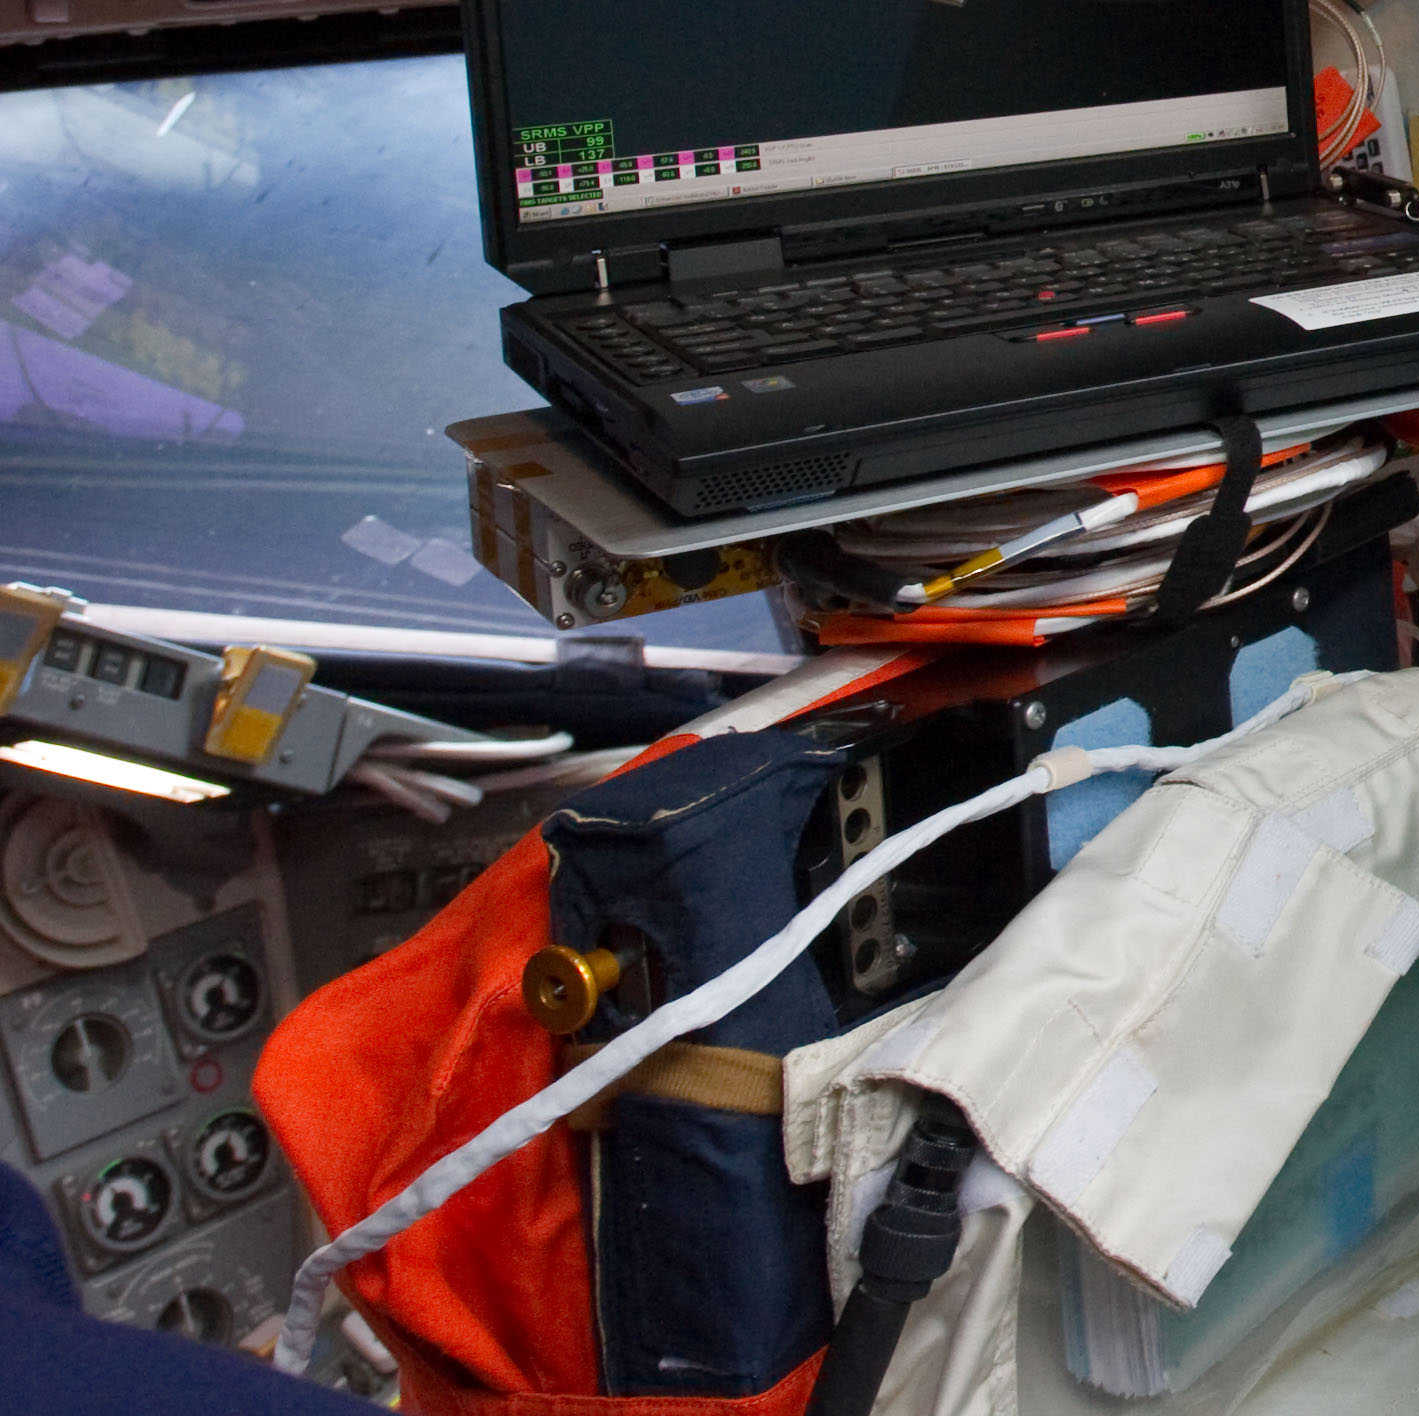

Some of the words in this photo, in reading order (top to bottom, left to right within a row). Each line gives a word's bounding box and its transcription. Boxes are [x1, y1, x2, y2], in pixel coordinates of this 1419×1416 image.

[520, 126, 567, 140] SRMS
[572, 123, 604, 134] VPP
[523, 143, 547, 153] UB
[586, 136, 604, 146] 99
[524, 156, 546, 166] LB
[579, 150, 604, 160] 137
